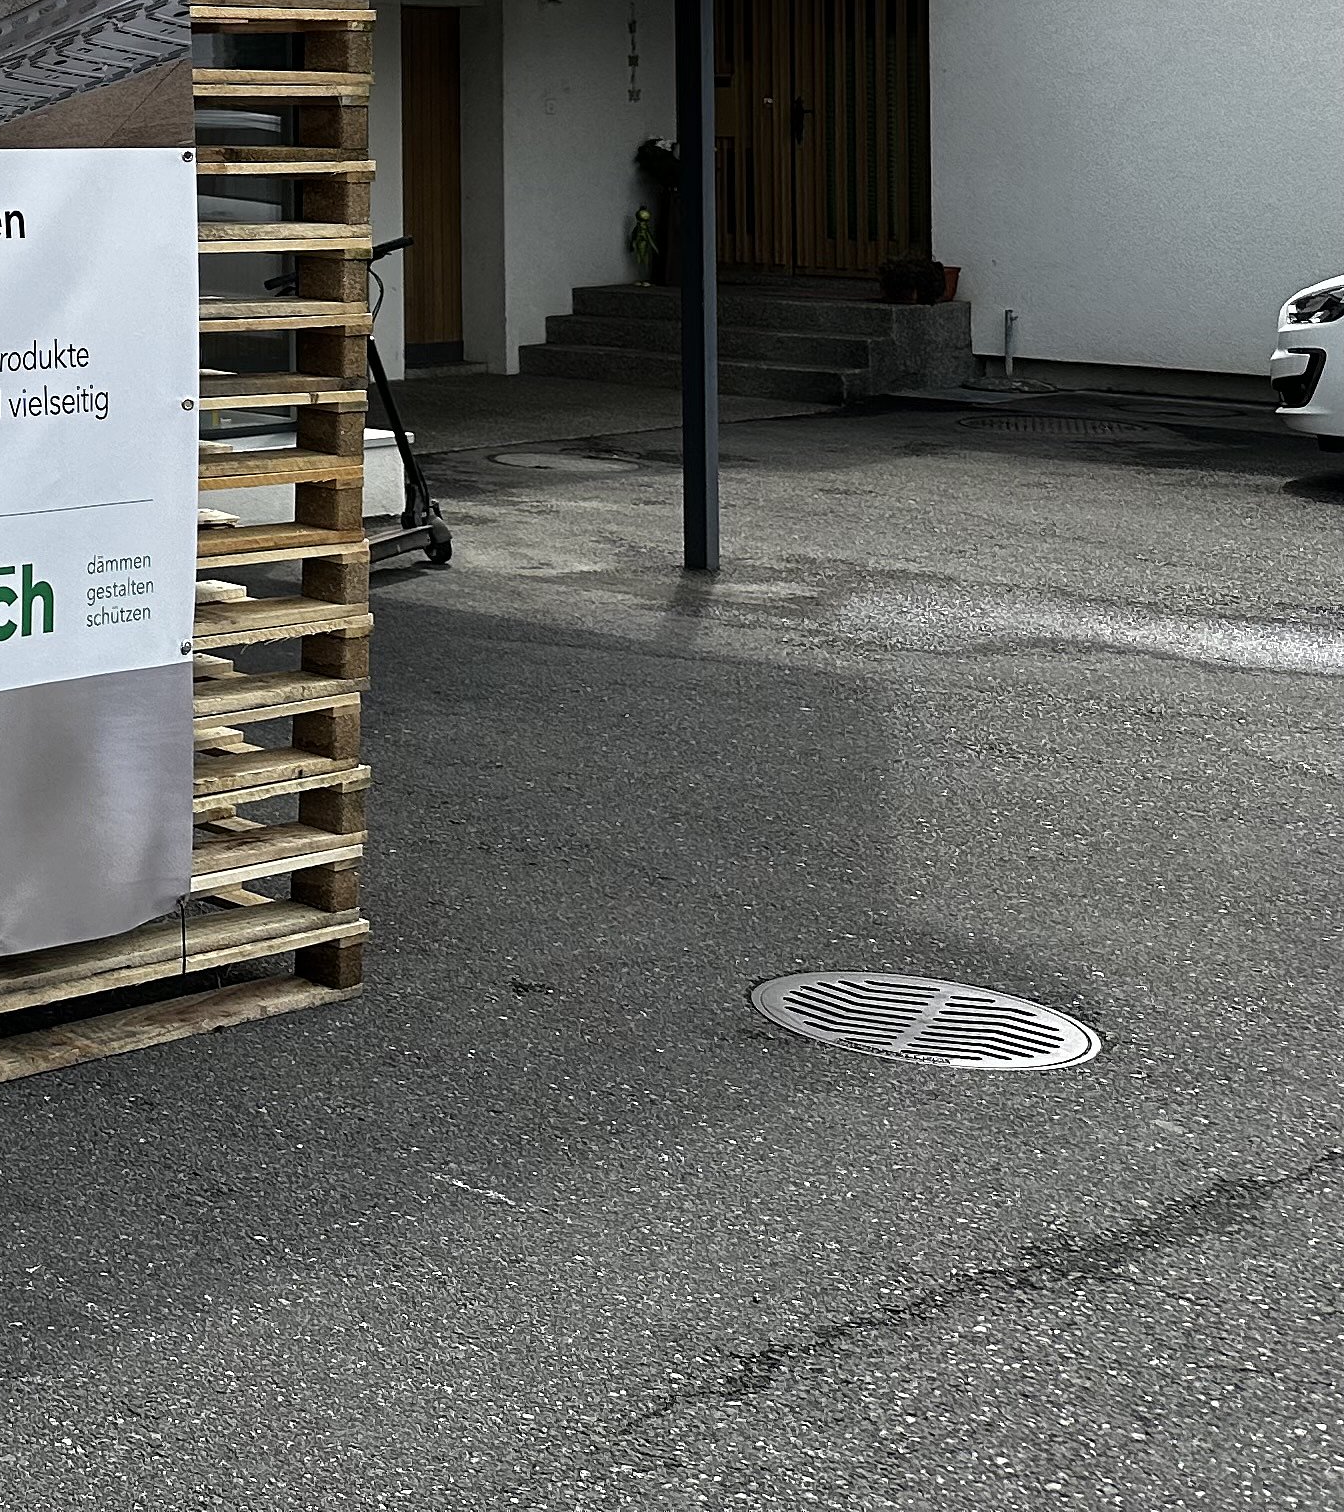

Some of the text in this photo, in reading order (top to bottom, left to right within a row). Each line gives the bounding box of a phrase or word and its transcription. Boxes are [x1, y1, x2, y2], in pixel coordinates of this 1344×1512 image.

[8, 384, 109, 421] vielseitig
[86, 554, 151, 575] dämmen
[86, 577, 154, 604] gestalten
[86, 603, 151, 628] schützen
